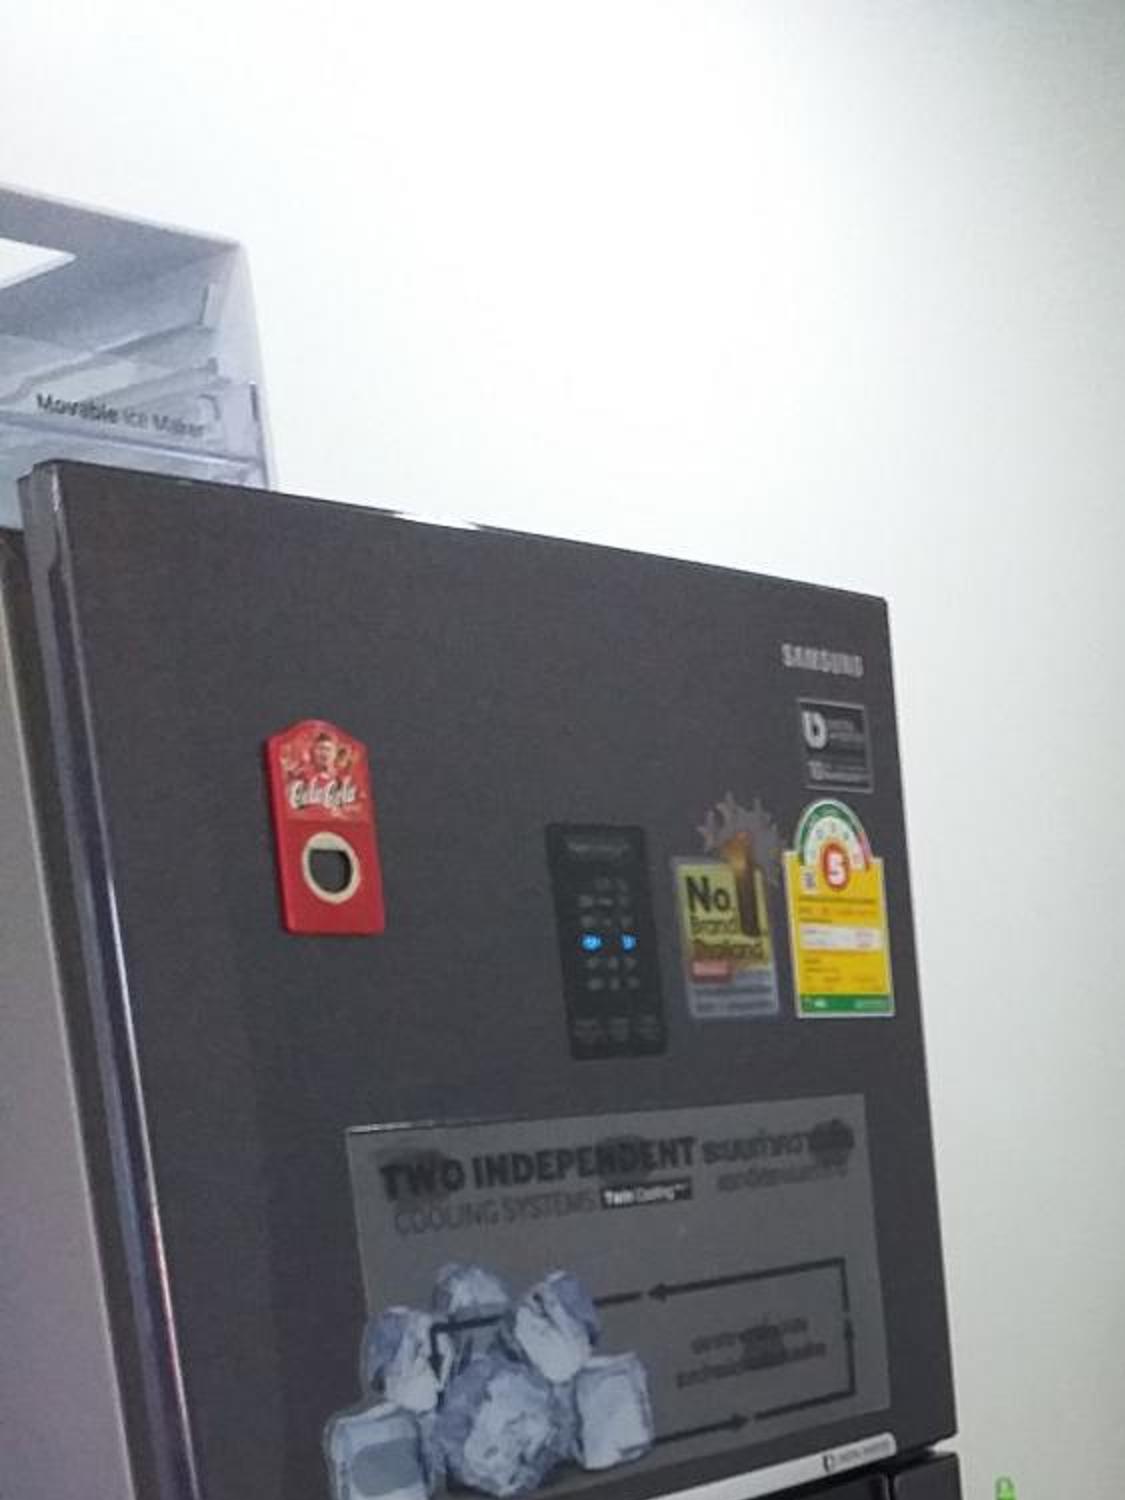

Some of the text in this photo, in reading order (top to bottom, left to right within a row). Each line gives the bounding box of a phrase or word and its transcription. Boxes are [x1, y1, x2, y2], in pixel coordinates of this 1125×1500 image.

[36, 392, 119, 425] Movable
[782, 643, 864, 678] SAMSUNG
[380, 1156, 466, 1201] TWO
[472, 1135, 697, 1190] INDEPENDENT
[394, 1199, 499, 1236] COOLING
